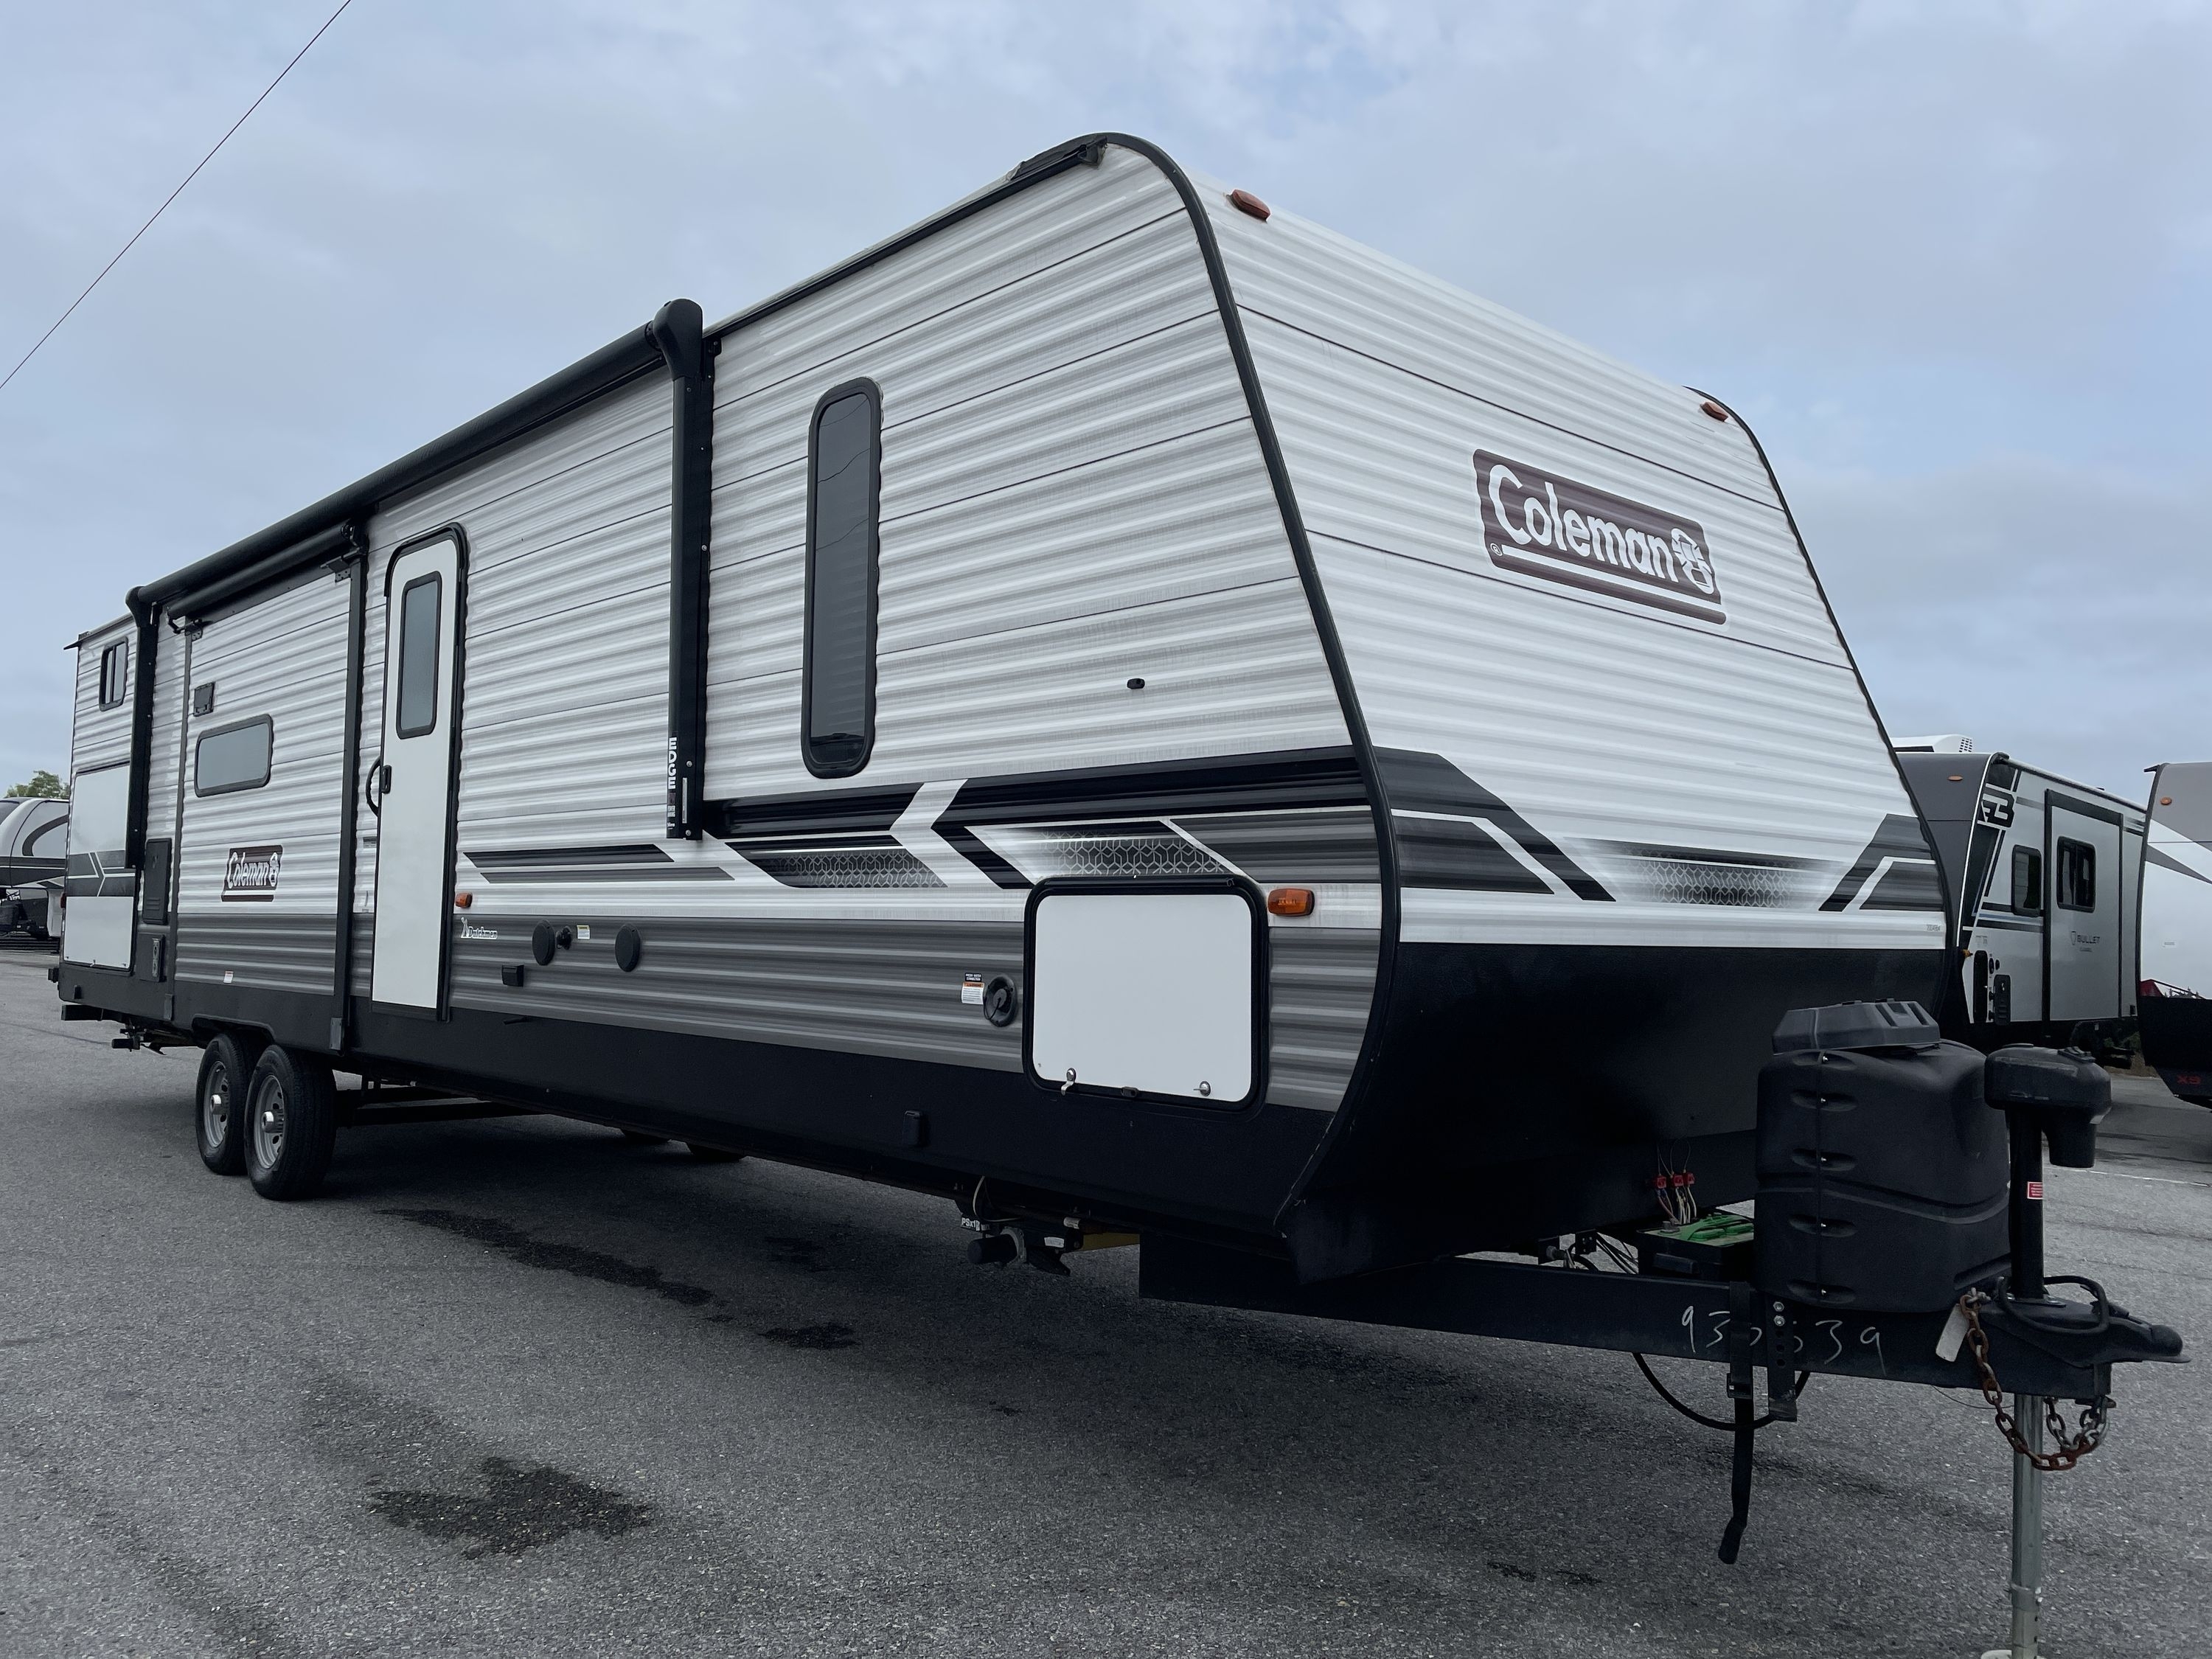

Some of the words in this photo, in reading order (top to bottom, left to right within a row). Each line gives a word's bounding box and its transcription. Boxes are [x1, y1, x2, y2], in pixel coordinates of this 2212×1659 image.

[1489, 464, 1679, 582] Coleman
[668, 737, 678, 790] EDGE
[227, 852, 270, 889] Coleman
